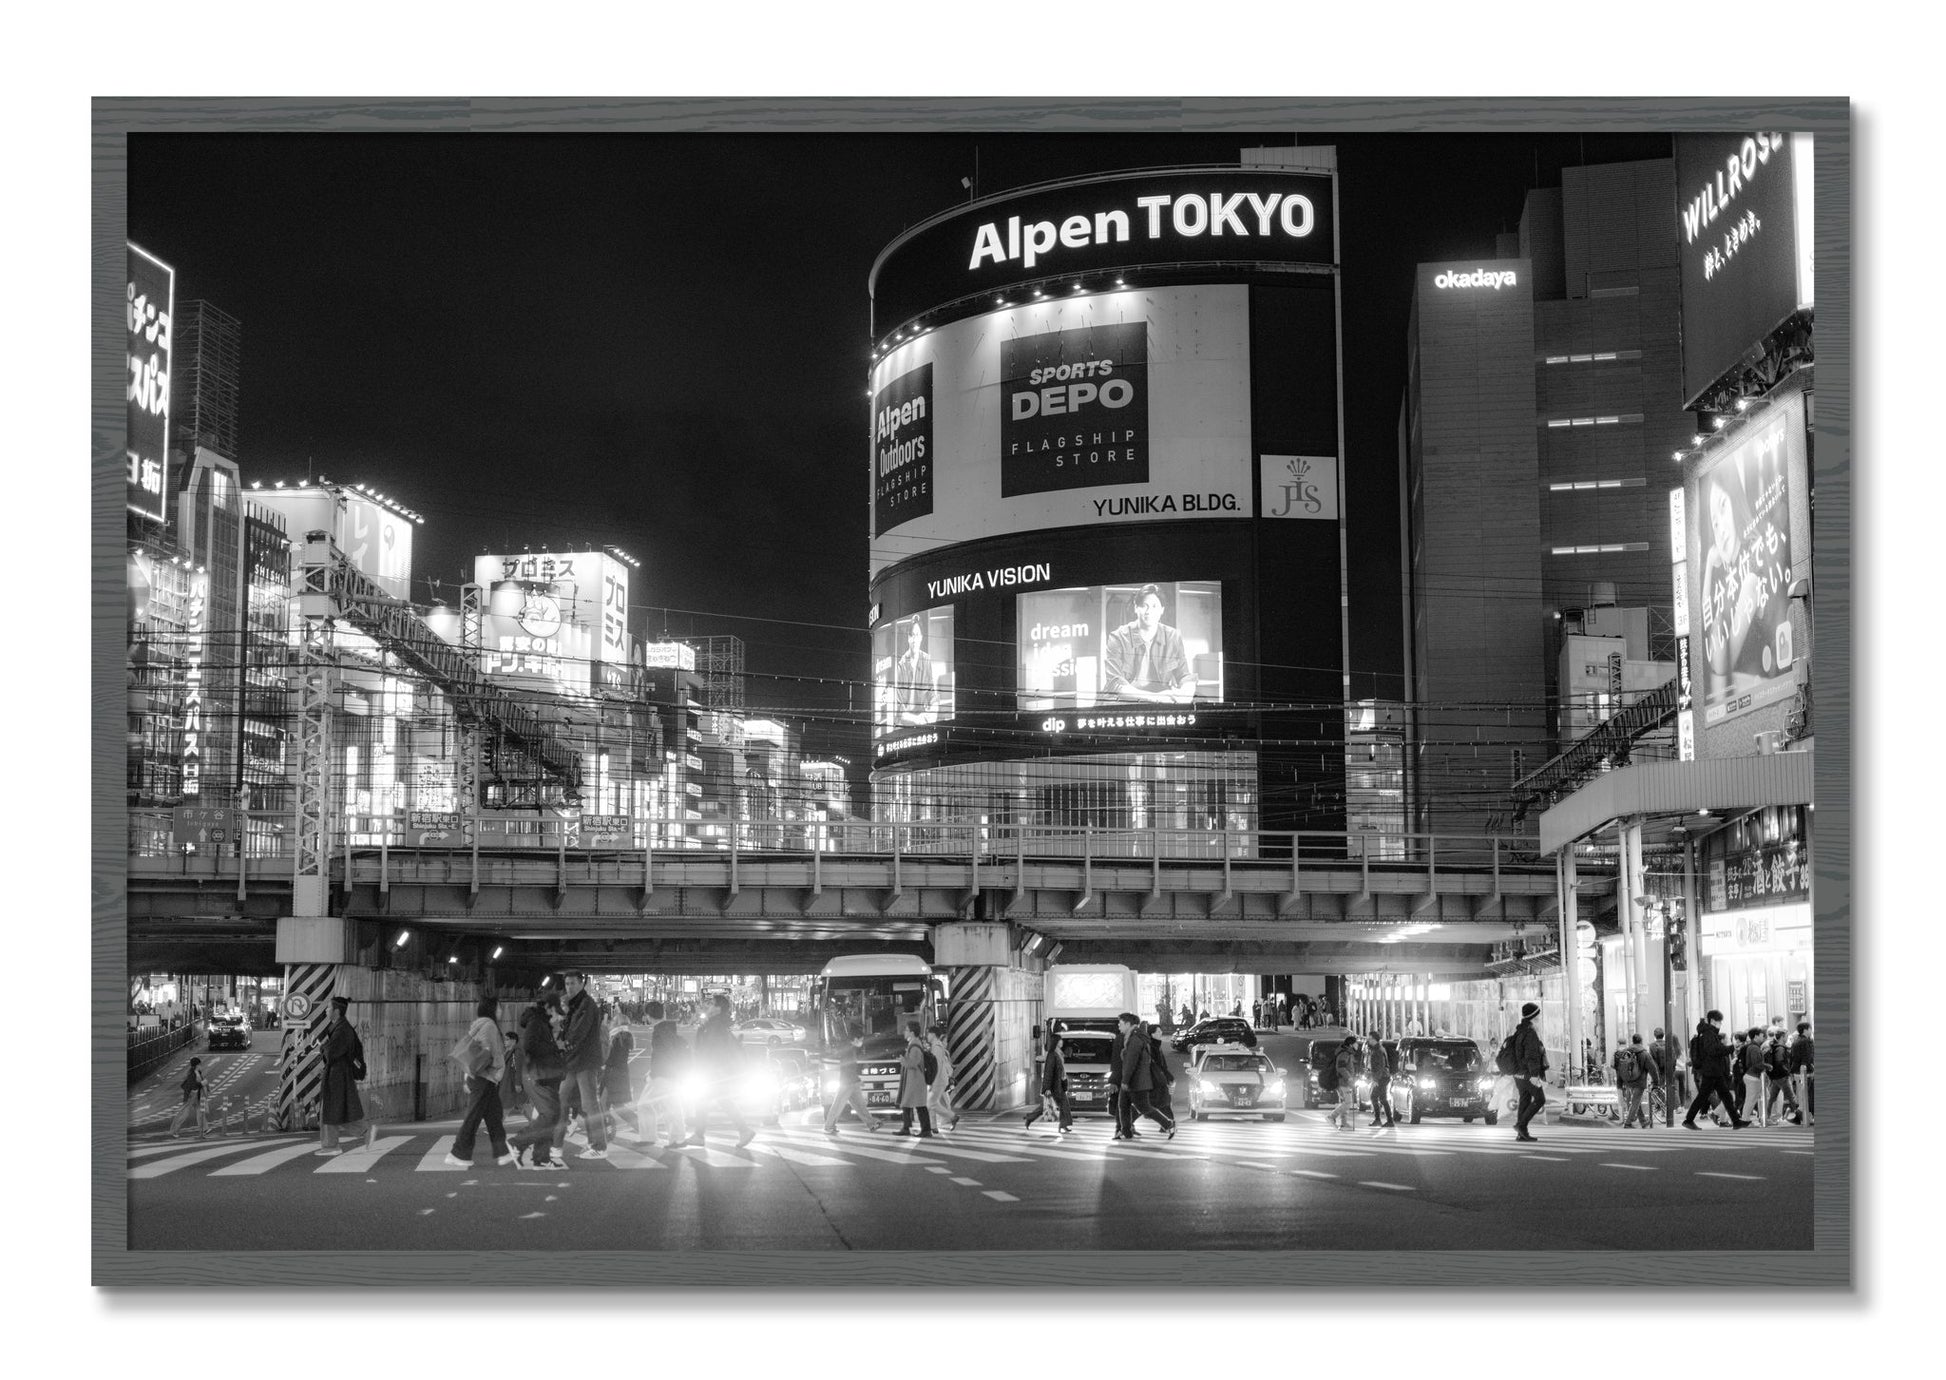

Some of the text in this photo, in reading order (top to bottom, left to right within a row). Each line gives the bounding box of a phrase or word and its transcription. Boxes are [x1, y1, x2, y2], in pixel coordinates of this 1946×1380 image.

[968, 192, 1315, 270] Alpen TOKYO
[1434, 268, 1516, 290] okadaya
[1029, 358, 1114, 385] SPORTS
[1011, 379, 1134, 422] DEPO
[876, 395, 926, 443] Alpen
[1011, 429, 1136, 455] FLAGSHIP
[880, 435, 925, 478] Outdoors
[1055, 449, 1136, 467] STORE
[876, 465, 927, 500] FLAGSHIP
[890, 482, 927, 507] STORE
[1093, 493, 1241, 517] YUNIKA BLDG.
[254, 563, 286, 585] SHISHA
[502, 557, 576, 579] プロミス
[927, 562, 1051, 599] YUNIKA VISION
[1030, 622, 1089, 641] dream
[1042, 714, 1196, 733] dip 夢を叶える仕事に出会おう
[411, 812, 459, 823] 新宿駅東口
[582, 815, 628, 826] 新宿駅東口
